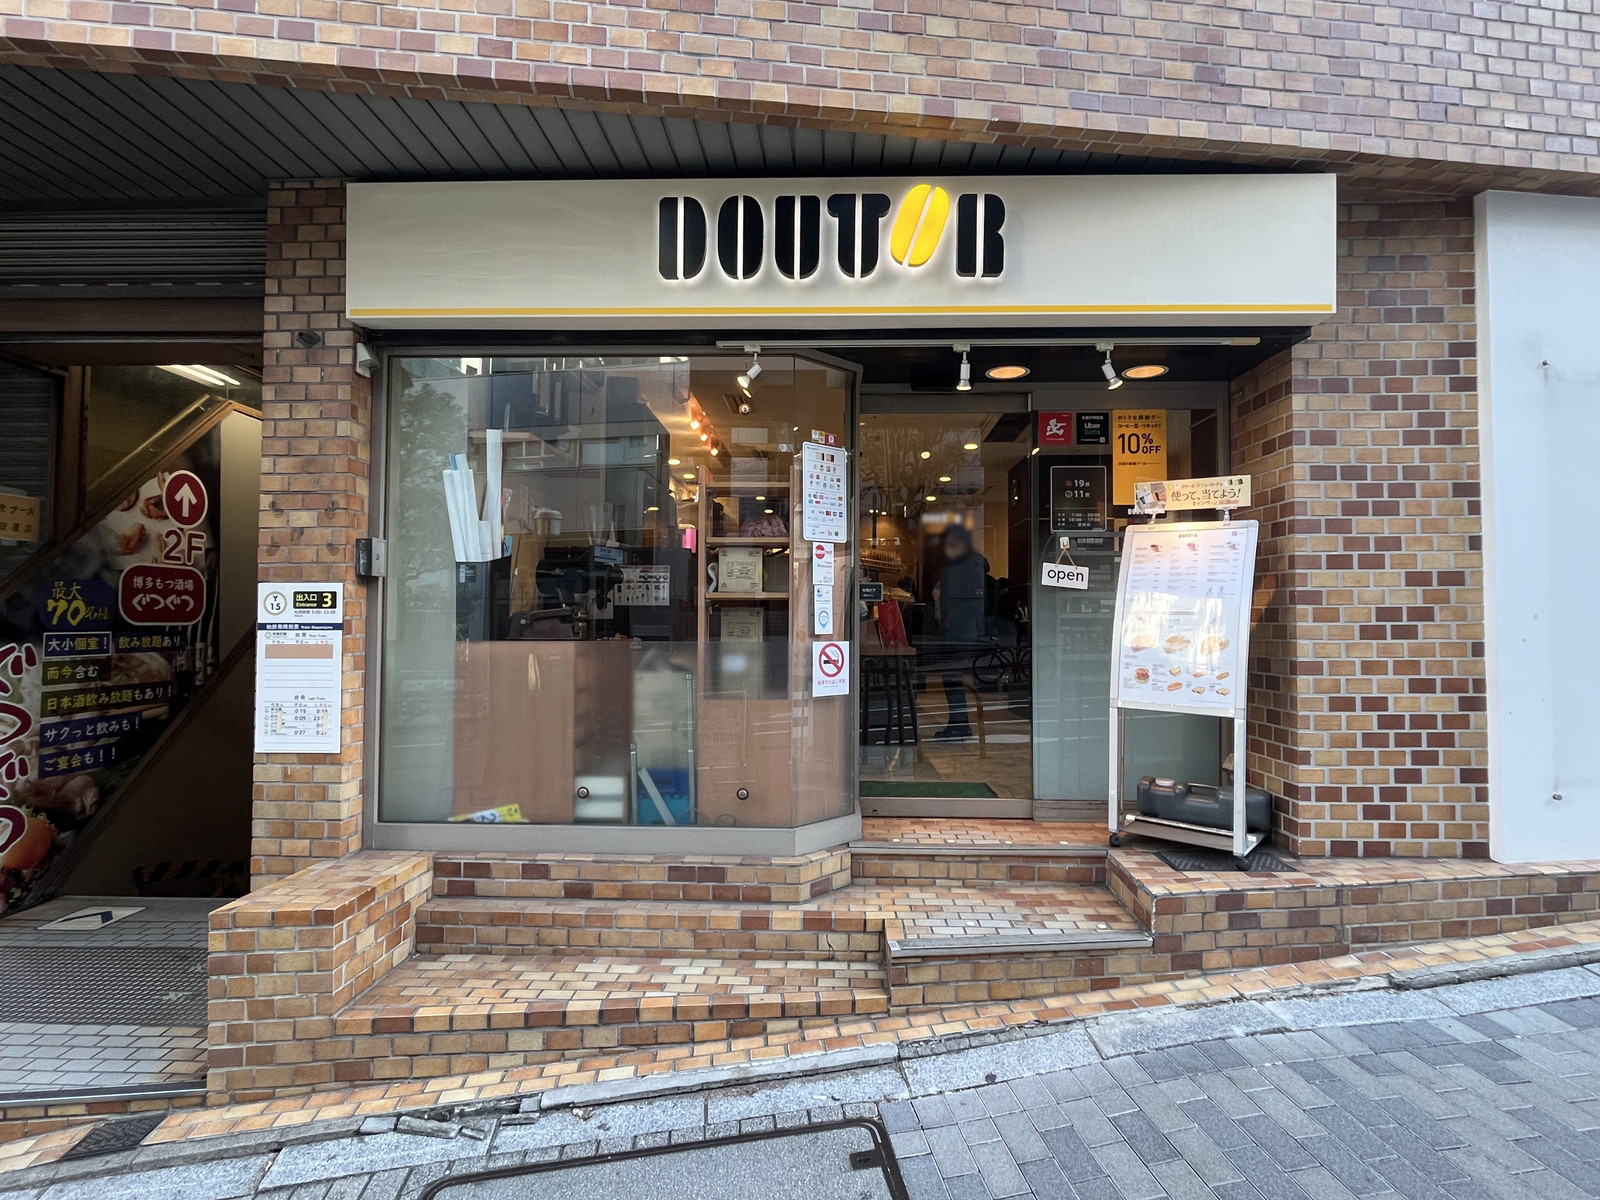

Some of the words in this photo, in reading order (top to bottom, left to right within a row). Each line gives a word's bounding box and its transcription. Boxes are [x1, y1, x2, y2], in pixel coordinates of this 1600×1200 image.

[658, 184, 1006, 280] DOUTOR
[1142, 445, 1162, 454] OFF
[1170, 487, 1242, 502] 使って、当てよう!
[163, 529, 205, 565] 2F
[133, 576, 195, 591] 博多もつ酒場
[1047, 569, 1084, 584] open
[51, 581, 83, 600] 最大
[132, 593, 195, 612] ぐつぐつ
[322, 593, 332, 608] 3
[47, 637, 109, 652] 大小個室!
[118, 635, 182, 649] 飲み放題あり
[47, 665, 99, 680] 而今含む
[47, 685, 173, 711] 日本酒飲み放題もあり!
[44, 717, 140, 742] サクっと飲みも!
[44, 747, 116, 771] ご宴会も!!
